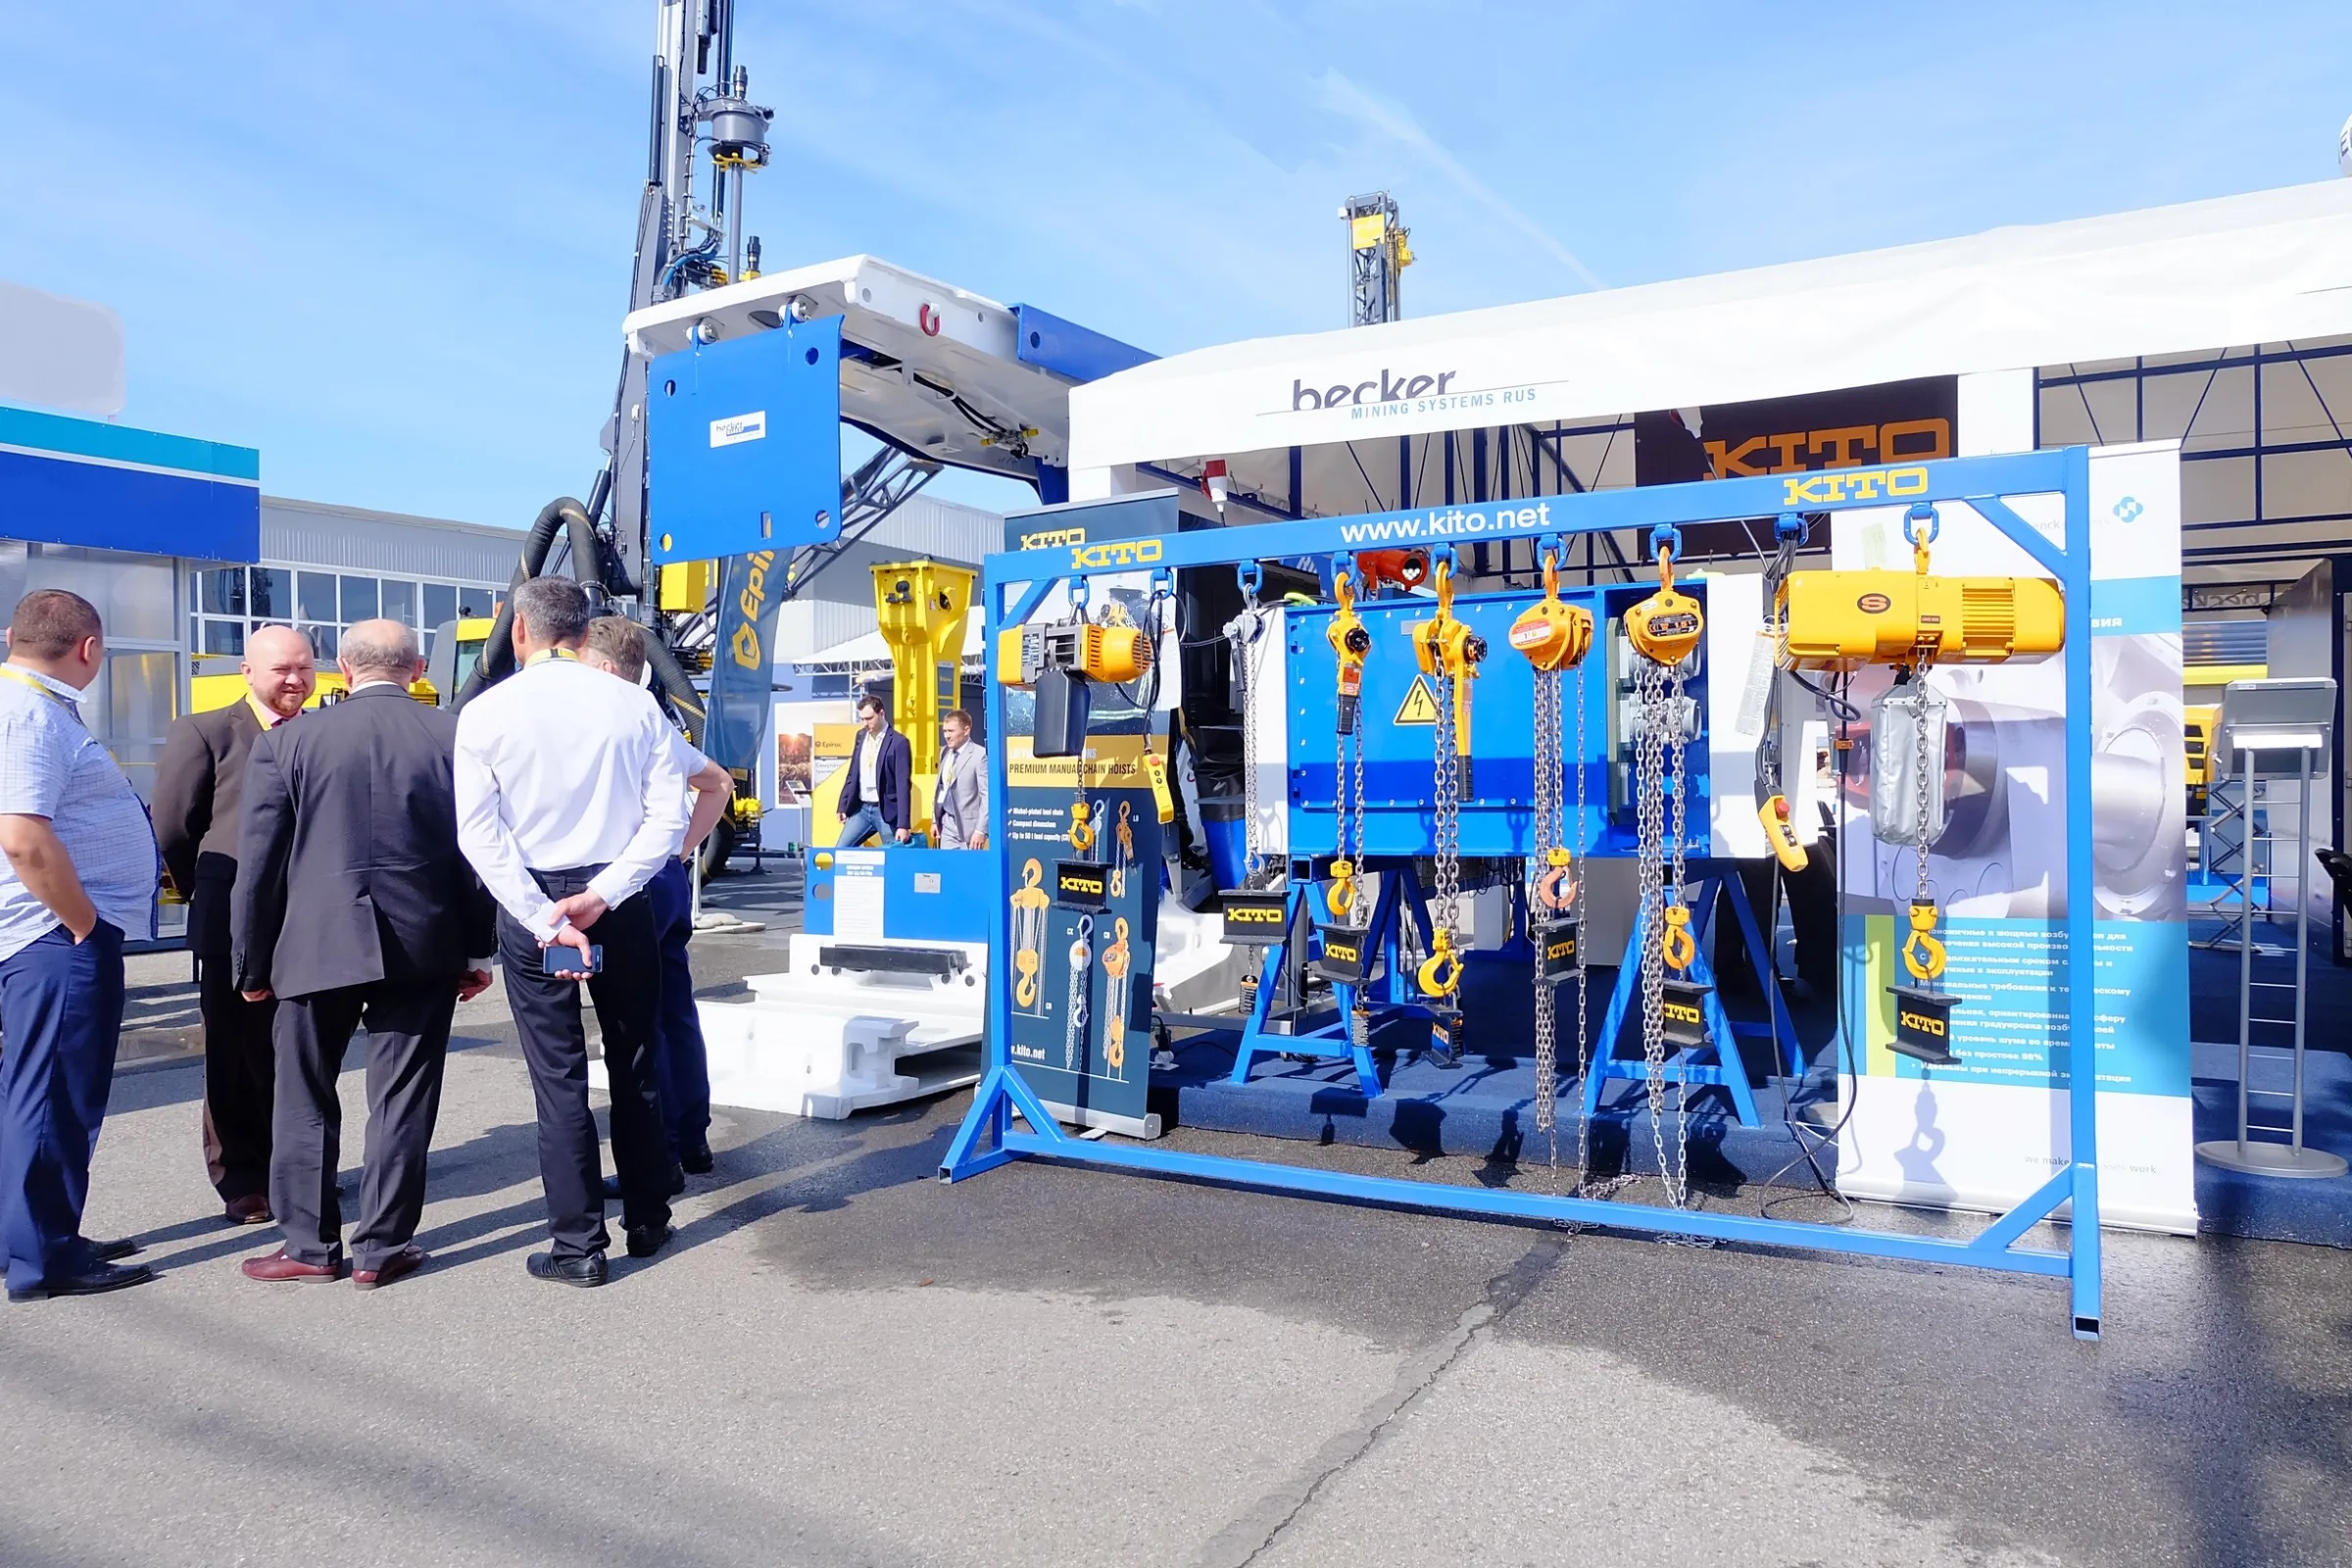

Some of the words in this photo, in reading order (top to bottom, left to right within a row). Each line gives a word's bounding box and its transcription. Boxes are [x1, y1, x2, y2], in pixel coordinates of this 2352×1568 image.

[1293, 368, 1457, 412] becker
[1351, 403, 1409, 419] MINING
[1417, 393, 1494, 413] SYSTEMS
[1503, 387, 1537, 404] RUS
[1702, 417, 1949, 481] KITO
[1784, 466, 1929, 506] KITO
[1340, 502, 1551, 543] www.kito.net
[1020, 527, 1086, 552] KITO
[1071, 539, 1162, 569] KITO
[740, 549, 775, 622] Epi
[1008, 763, 1048, 774] PREMIUM
[1083, 763, 1105, 774] CHAIN
[1107, 763, 1137, 775] HOISTS
[1060, 876, 1103, 895] KITO
[1227, 907, 1283, 923] KITO
[1325, 943, 1357, 962] KITO
[1546, 940, 1576, 960] KITO
[1945, 956, 2020, 964] должительным
[1663, 1003, 1700, 1024] ITO
[1901, 1010, 1945, 1037] KITO
[1987, 1009, 2071, 1020] ориентированна
[2042, 1156, 2070, 1166] make
